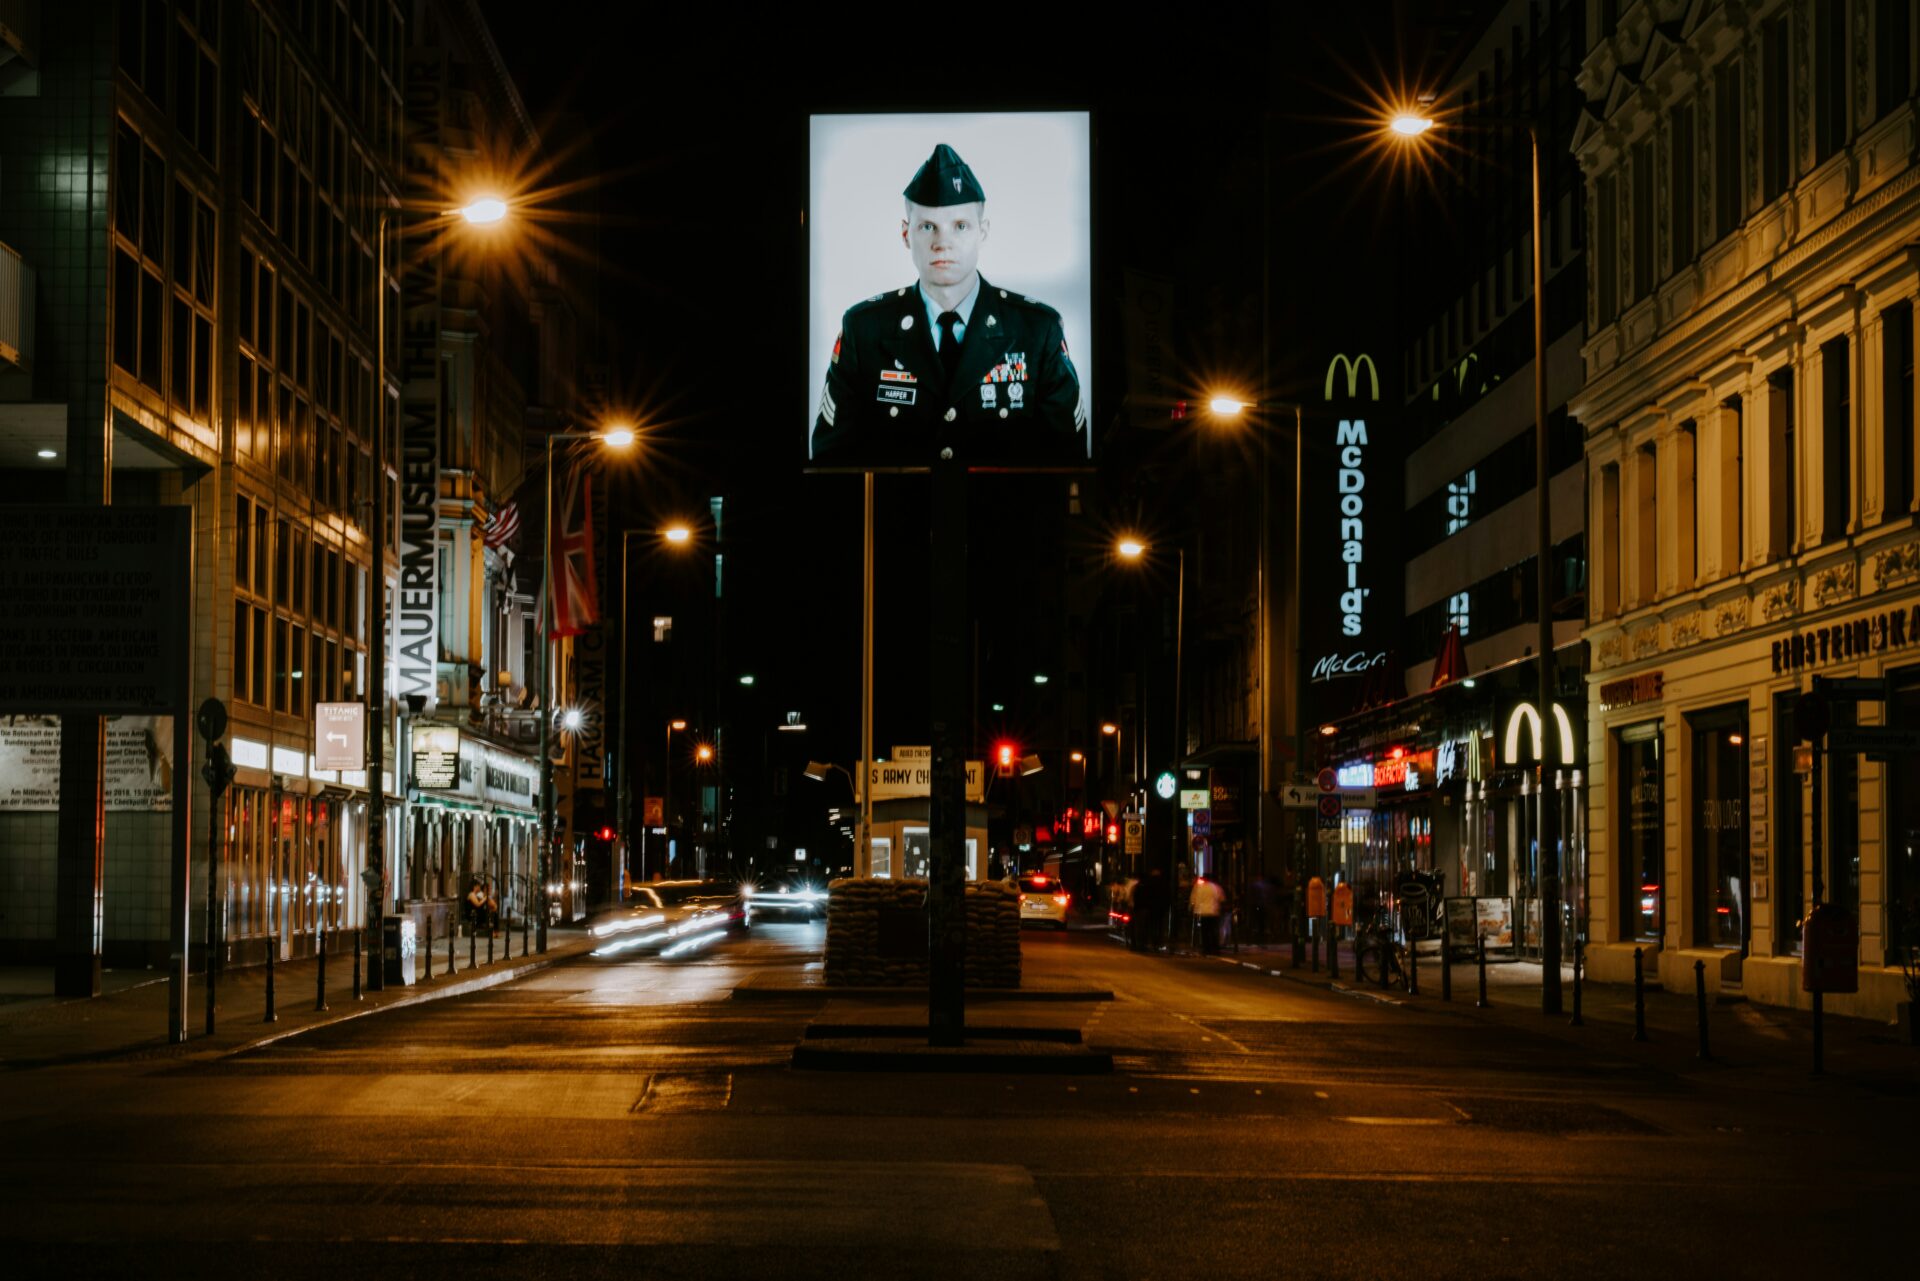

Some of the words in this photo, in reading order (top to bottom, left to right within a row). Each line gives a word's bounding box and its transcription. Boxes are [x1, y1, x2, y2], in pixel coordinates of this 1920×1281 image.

[406, 58, 441, 144] MUR
[404, 319, 437, 384] THE
[885, 389, 907, 400] HARPER
[57, 512, 112, 528] AMERICAN
[118, 512, 159, 528] SECTOR
[1336, 419, 1370, 636] McDonald's
[97, 529, 157, 544] FORBIDDEN
[66, 546, 99, 560] RULES
[399, 403, 437, 700] MAUERMUSEUM
[47, 628, 93, 642] SECTEUR
[1772, 618, 1869, 673] EINSTEIN
[77, 660, 145, 673] CIRCULATION
[20, 686, 112, 700] AMERIKANISCHEN
[115, 686, 156, 700] SEKTOR
[124, 748, 147, 756] Charlie
[883, 769, 911, 784] ARMY
